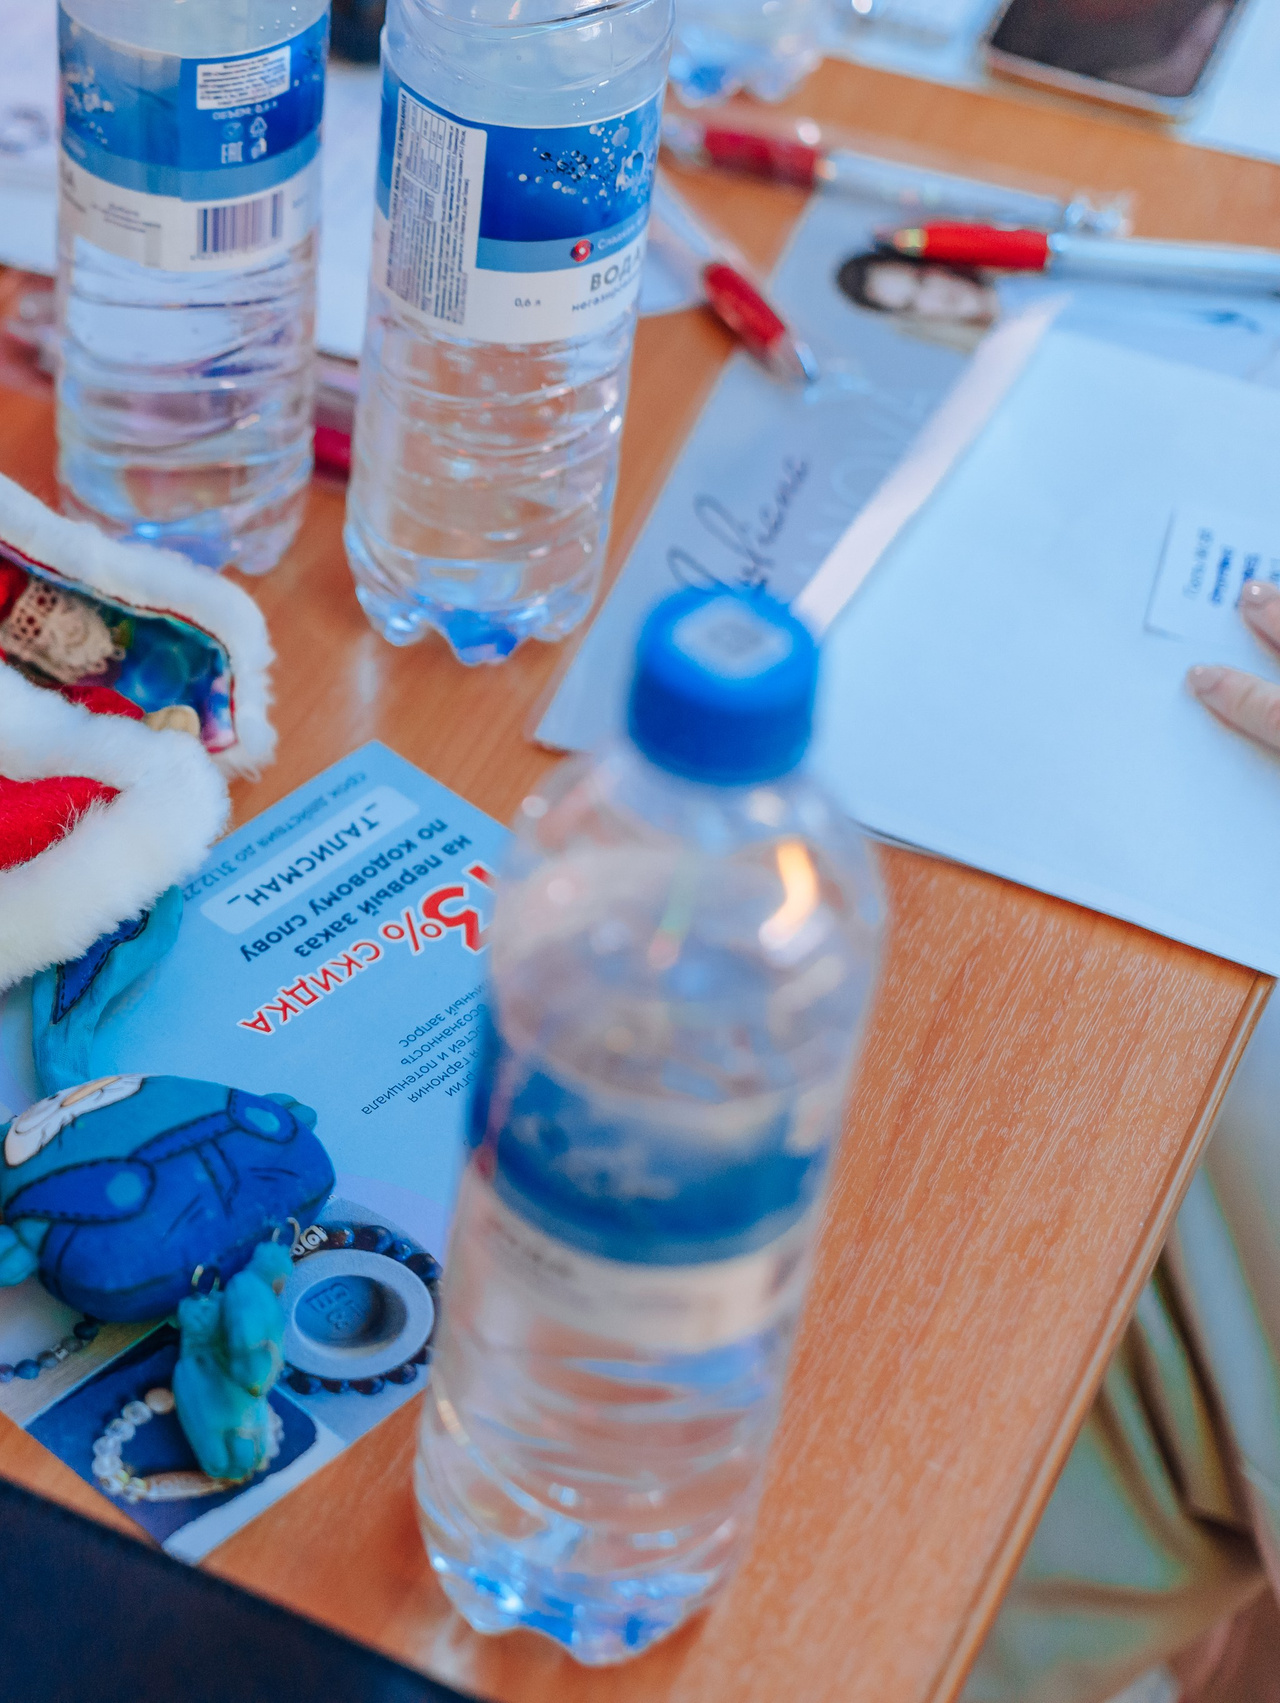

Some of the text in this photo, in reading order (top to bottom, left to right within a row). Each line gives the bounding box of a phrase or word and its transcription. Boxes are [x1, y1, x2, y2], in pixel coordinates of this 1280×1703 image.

[330, 770, 367, 798] срок
[256, 796, 329, 848] действия
[235, 843, 257, 863] до
[239, 817, 449, 962] по кодовому слову
[293, 834, 473, 958] на первый заказ
[240, 941, 381, 1034] СКИДКА
[398, 1013, 446, 1048] запрос
[400, 1003, 487, 1065] осознанность
[437, 1051, 449, 1061] и
[361, 1059, 438, 1115] потенциала
[407, 1056, 471, 1104] гармония
